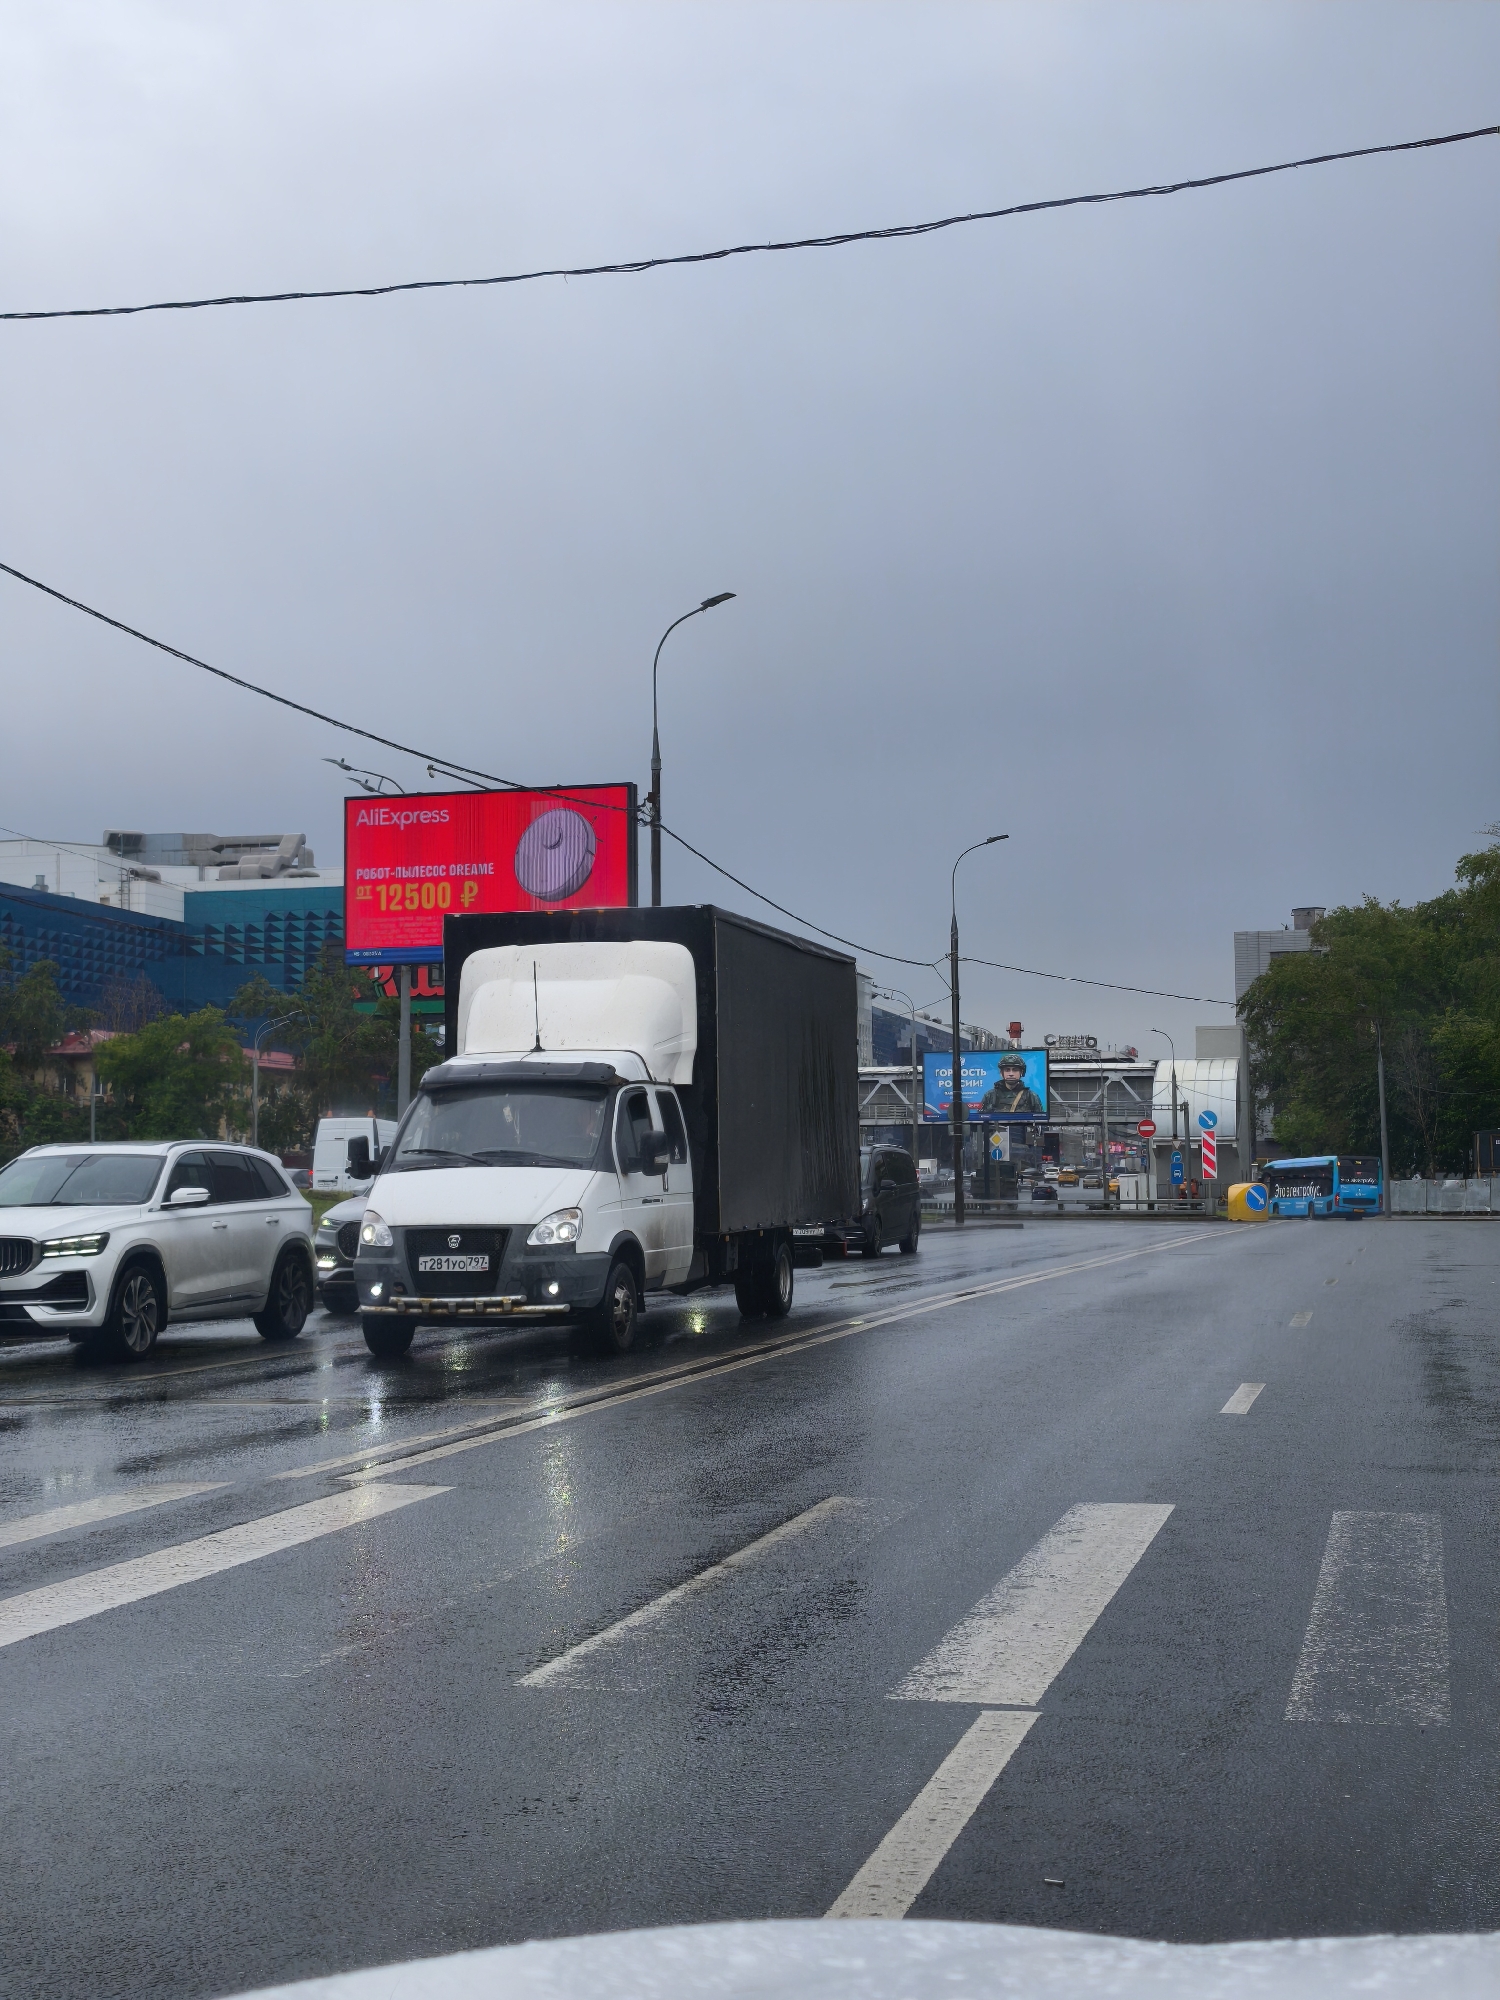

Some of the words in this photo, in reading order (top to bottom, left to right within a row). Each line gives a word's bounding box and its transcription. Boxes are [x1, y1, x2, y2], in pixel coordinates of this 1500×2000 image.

[356, 808, 450, 831] AliExpress
[356, 864, 447, 881] РОБОТ-ПЫЛЕСОС
[449, 862, 495, 876] DREAME
[376, 881, 451, 911] 12500
[935, 1068, 987, 1077] ГОРОСТЬ
[938, 1079, 983, 1088] РОСИИ!
[1274, 1183, 1286, 1198] Это
[422, 1257, 466, 1271] Т281УО
[467, 1256, 486, 1267] 797
